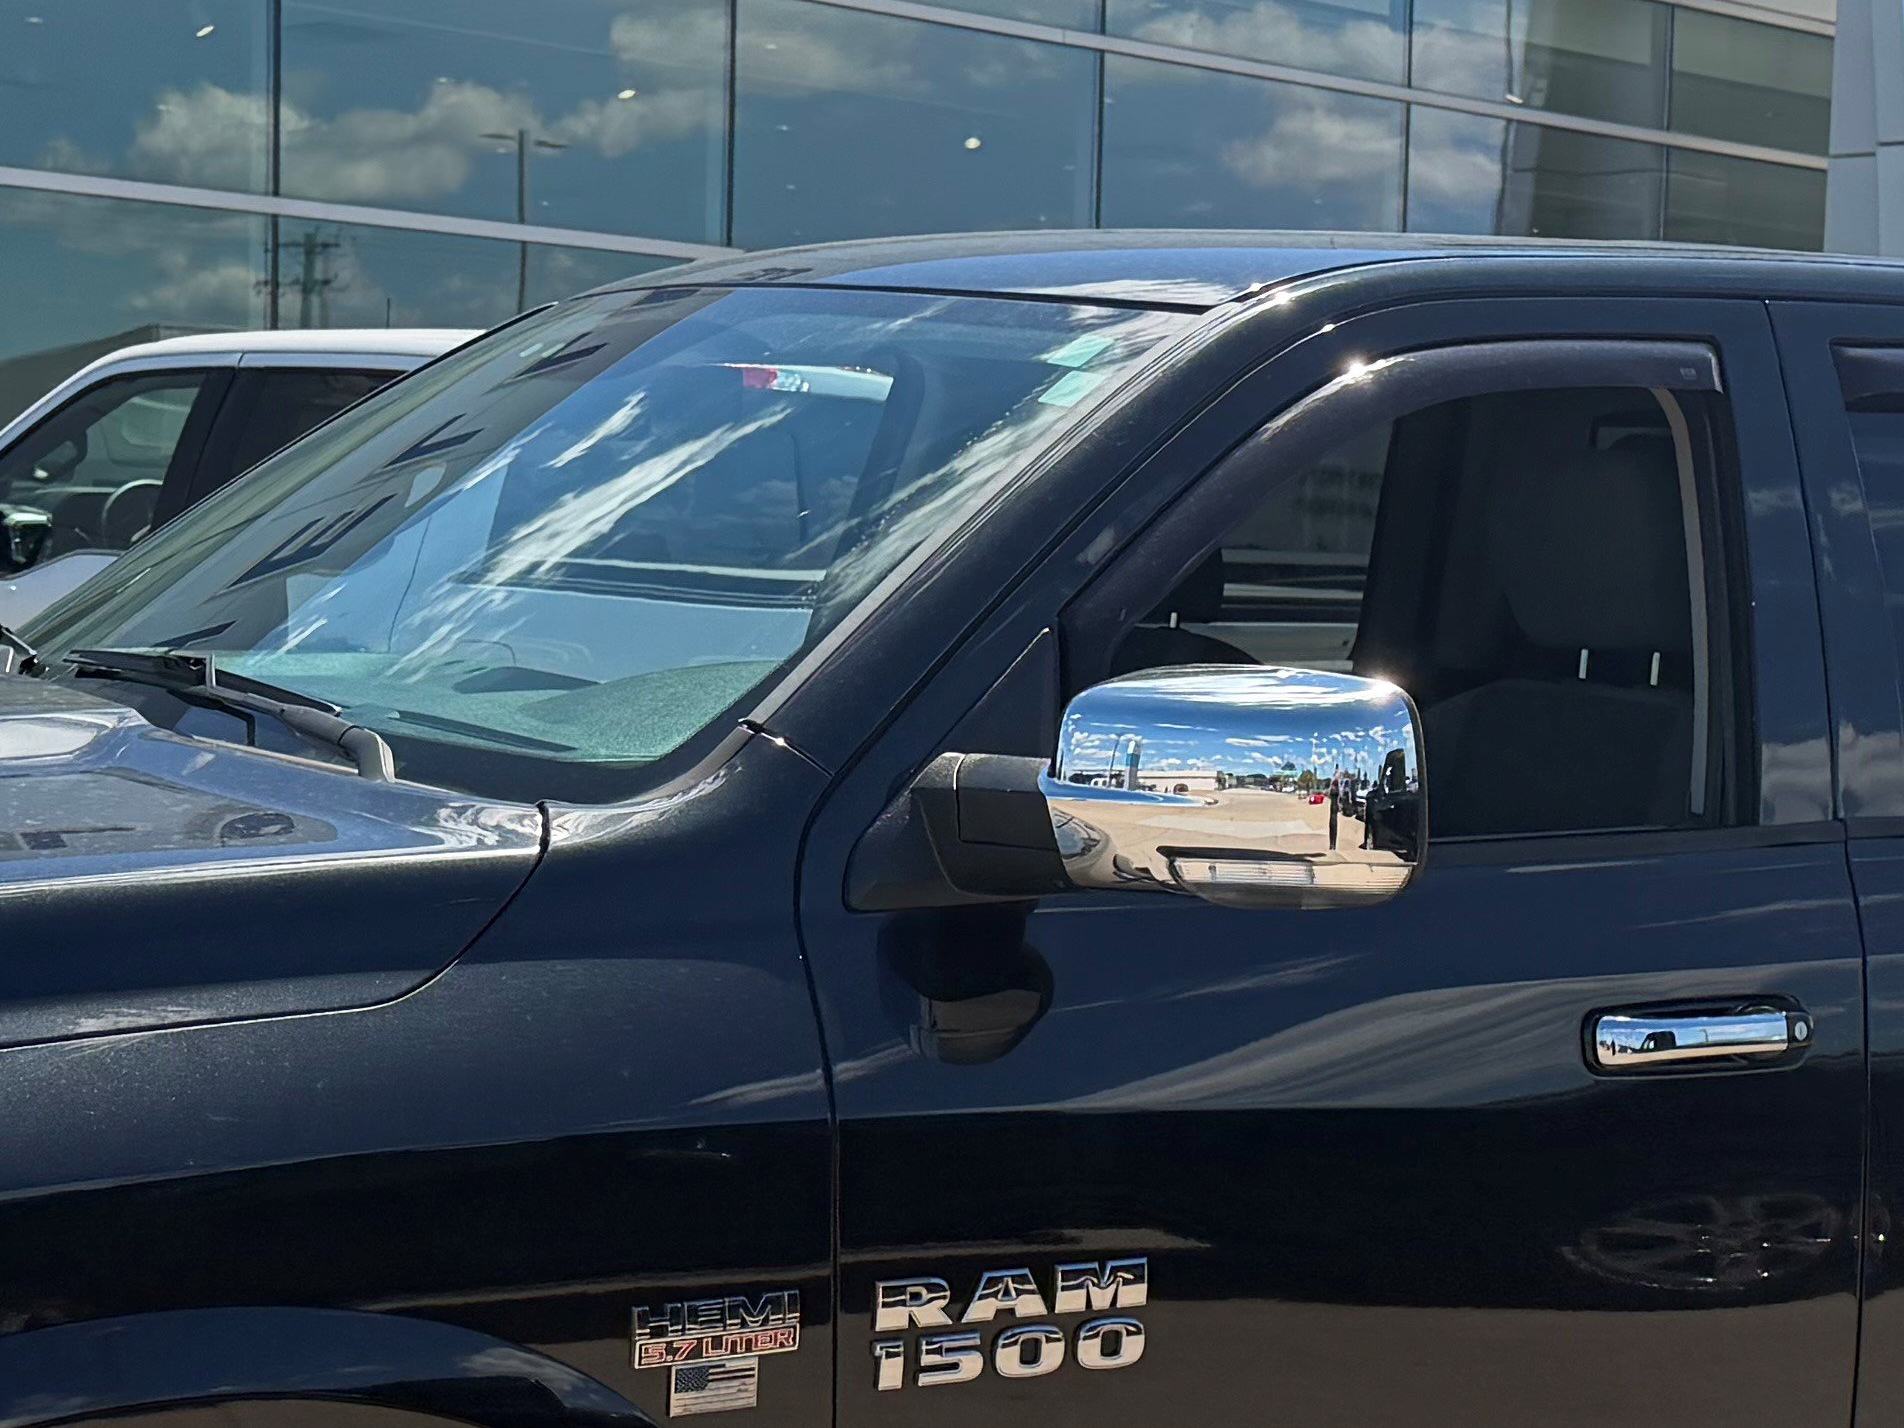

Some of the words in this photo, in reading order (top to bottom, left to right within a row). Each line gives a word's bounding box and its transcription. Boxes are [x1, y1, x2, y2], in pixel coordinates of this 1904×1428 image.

[632, 1289, 800, 1340] HEMI
[875, 1256, 1148, 1332] RAM
[640, 1339, 698, 1365] 5.7
[702, 1328, 795, 1358] LITER
[871, 1316, 1146, 1391] 1500
